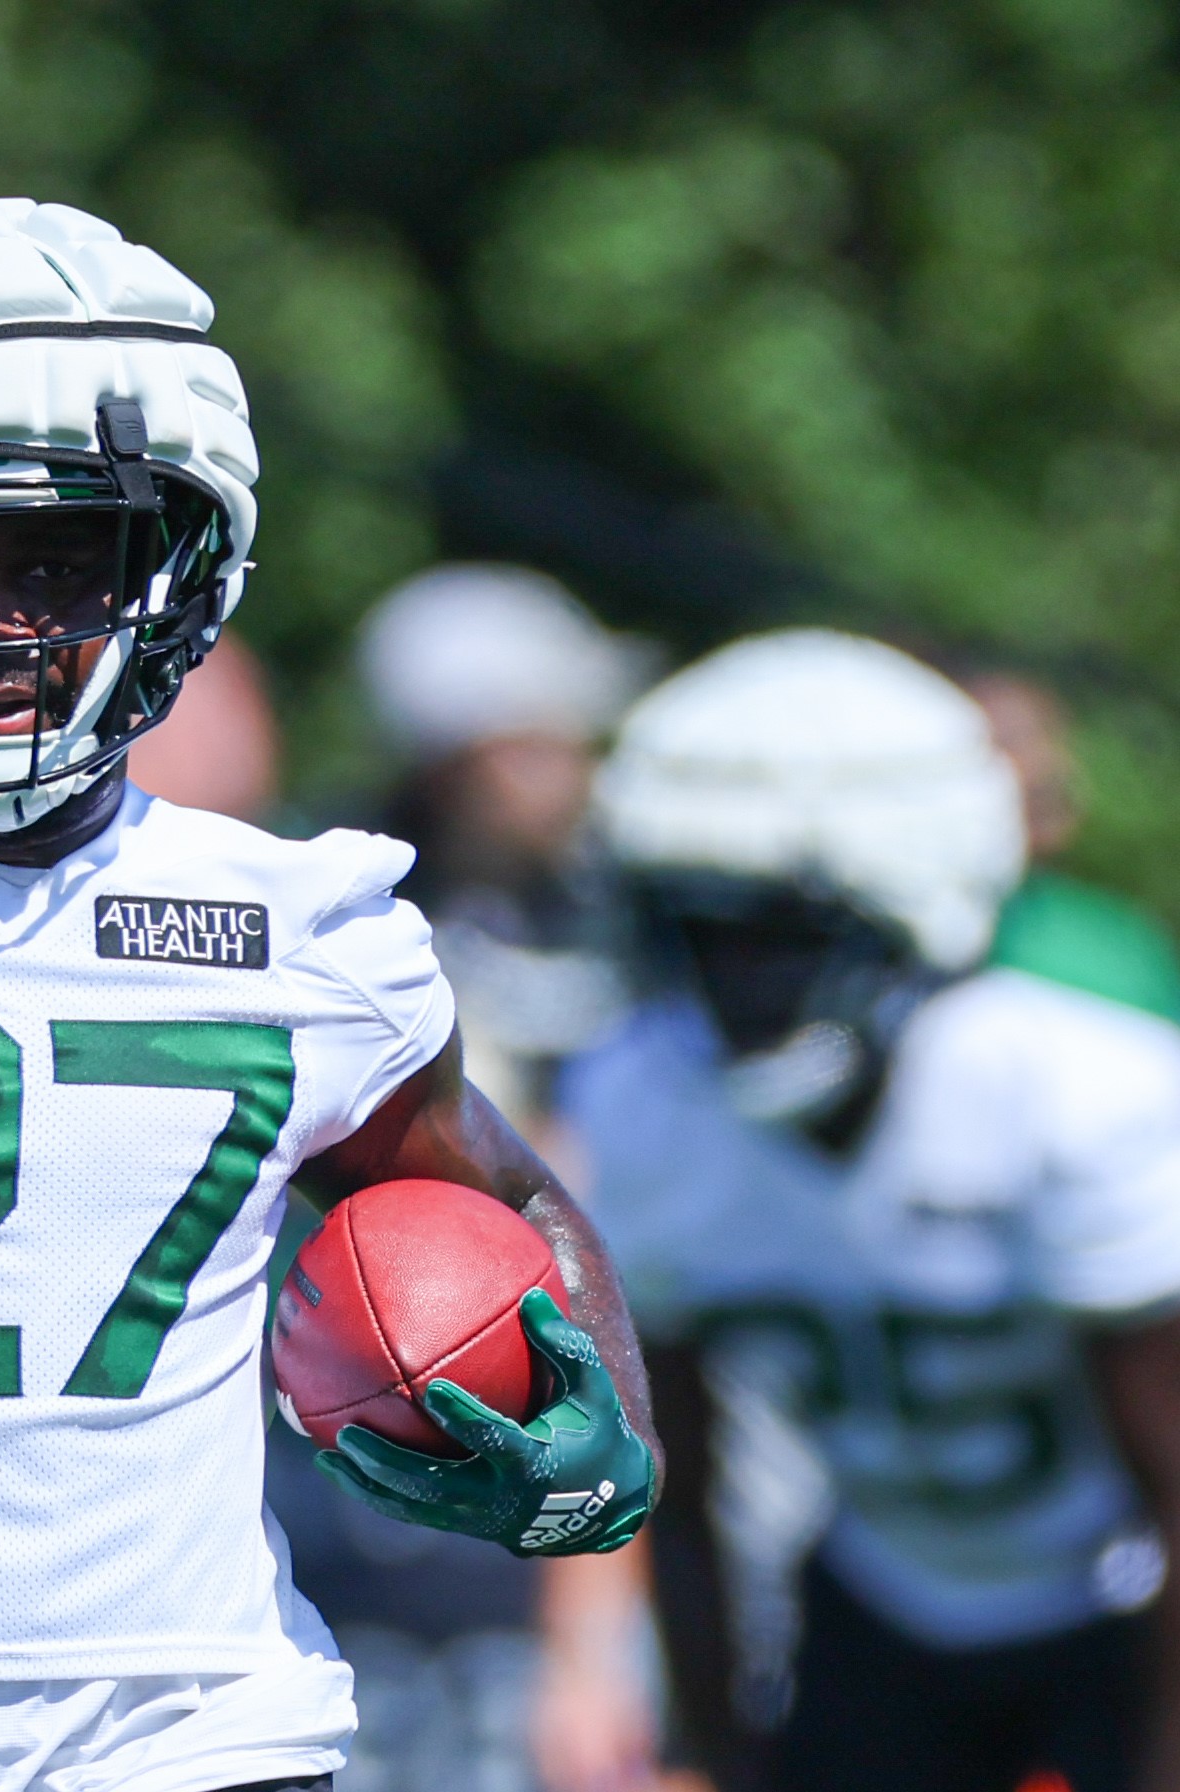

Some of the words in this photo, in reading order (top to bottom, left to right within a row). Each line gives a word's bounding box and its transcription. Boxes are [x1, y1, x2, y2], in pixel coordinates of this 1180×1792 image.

[99, 900, 261, 936] ATLANTIC
[122, 927, 244, 962] HEALTH
[520, 1479, 616, 1549] adidas
